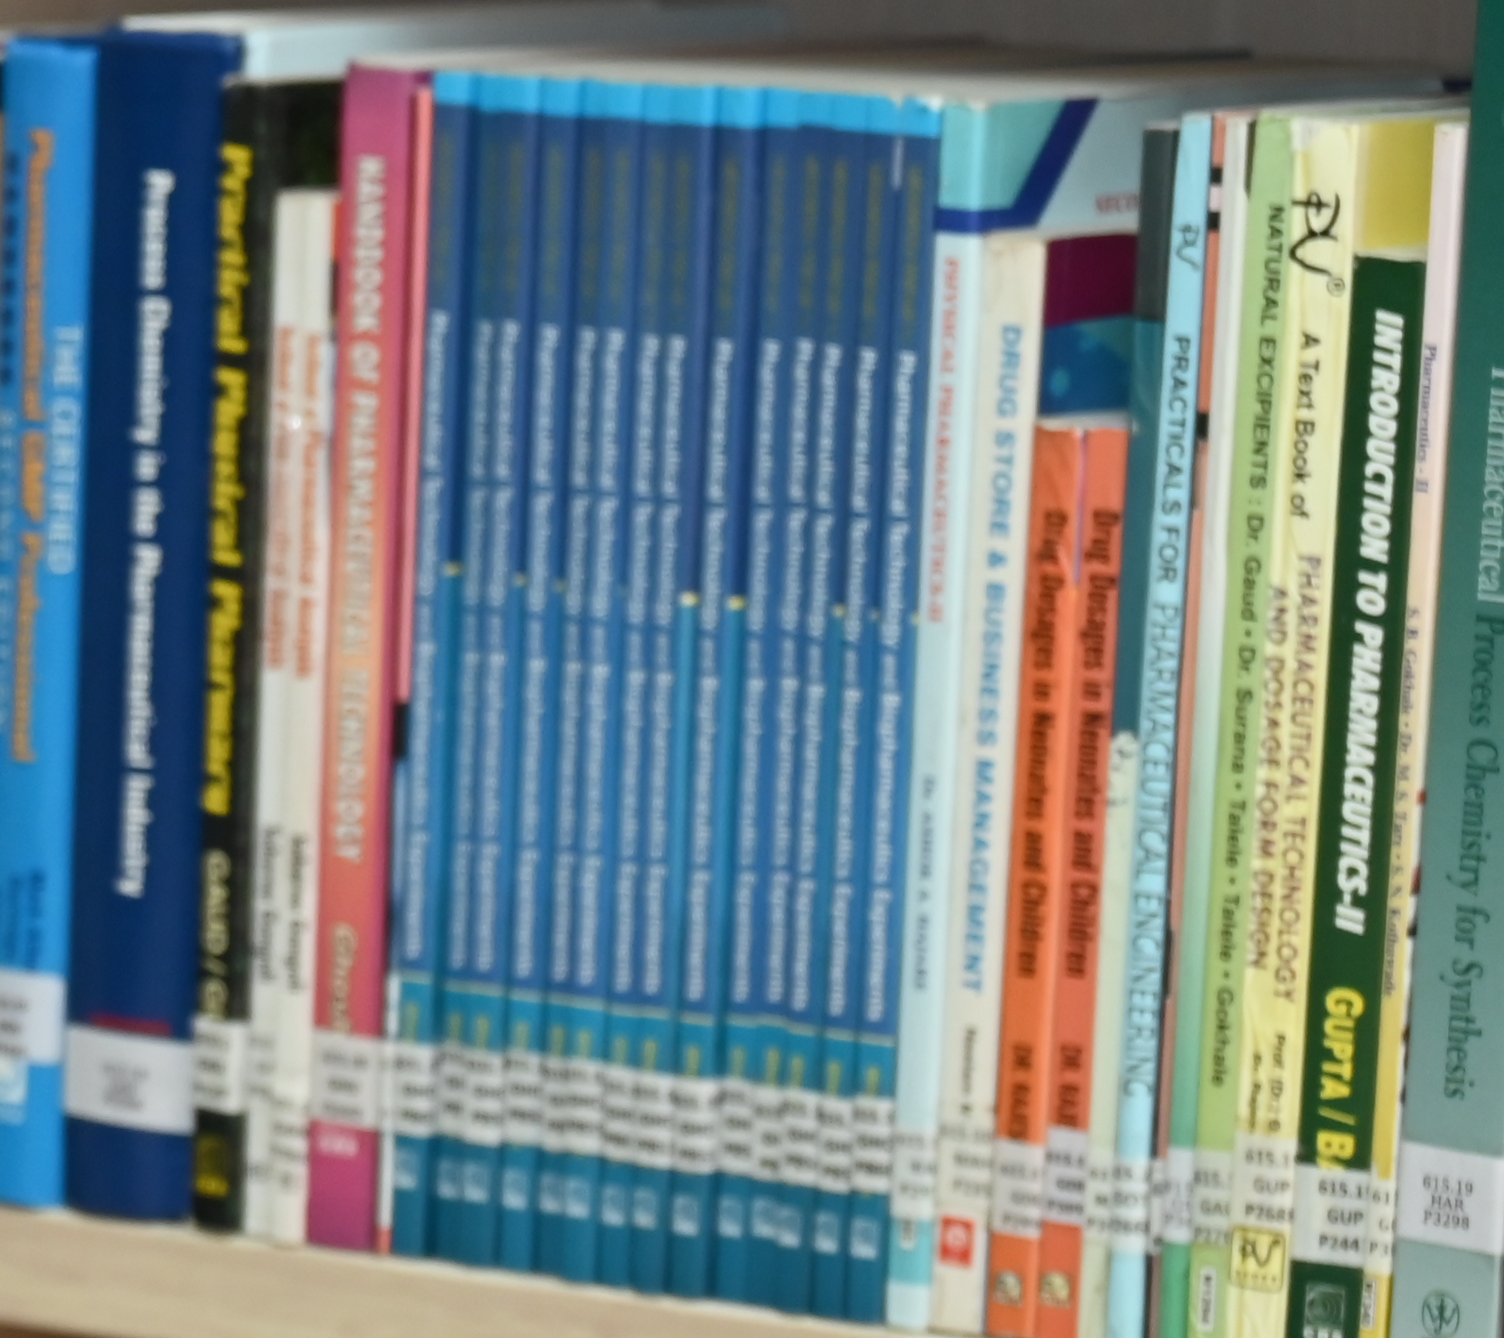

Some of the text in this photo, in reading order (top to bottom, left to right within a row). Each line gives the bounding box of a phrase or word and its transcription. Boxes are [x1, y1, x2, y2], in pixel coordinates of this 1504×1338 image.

[141, 170, 174, 289] Process
[1260, 205, 1286, 326] NATURAL
[130, 297, 170, 445] Chemistry
[1161, 335, 1190, 514] PRACTICALS
[1250, 336, 1277, 489] EXCIPIENTS
[1289, 333, 1321, 520] A Text Book of
[134, 487, 165, 536] the
[201, 143, 254, 815] Practical Physical Pharmacy
[334, 155, 384, 861] HANDBOOK OF PHARMACEUTICAL TECHNOLOGY
[1244, 514, 1265, 548] Dr.
[1156, 526, 1180, 584] FOR
[1240, 556, 1262, 621] Gaud
[123, 544, 164, 768] Pharmaceutical
[962, 324, 1023, 995] DRUG STORE & BUSINESS MANAGEMENT
[1237, 645, 1257, 679] Dr.
[1334, 310, 1405, 935] INTRODUCTION TO PHARMACEUTICS-II
[1470, 612, 1503, 726] Process
[1138, 603, 1176, 877] PHARMACEUTICAL
[1247, 585, 1290, 972] AND DOSAGE FORM DESIGN
[1272, 554, 1323, 1004] PHARMACEUTICAL TECHNOLOGY
[114, 774, 154, 897] Industry
[1446, 738, 1502, 896] Chemistry
[1455, 905, 1491, 950] for
[1320, 988, 1365, 1100] GUPTA
[1440, 962, 1484, 1100] Synthesis
[1422, 1174, 1474, 1197] 615.19
[1423, 1210, 1470, 1231] P3298
[1431, 1194, 1465, 1212] HAR
